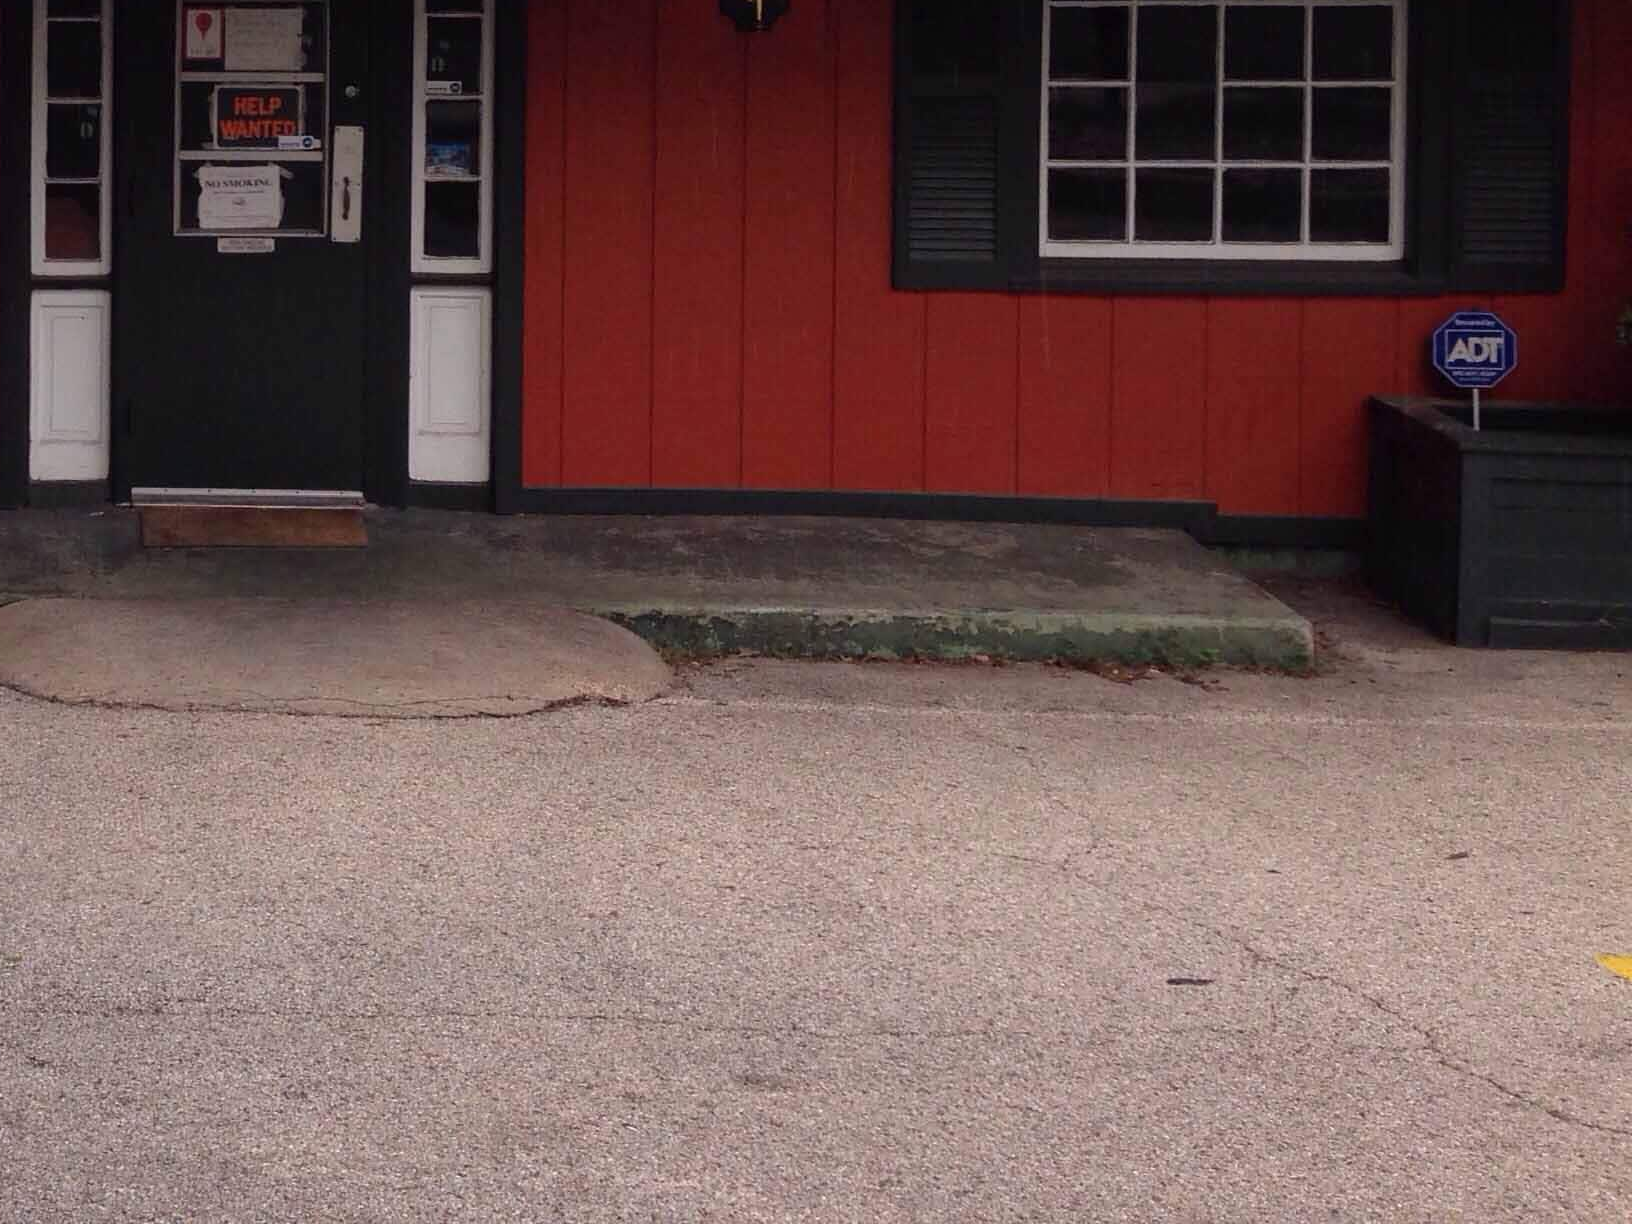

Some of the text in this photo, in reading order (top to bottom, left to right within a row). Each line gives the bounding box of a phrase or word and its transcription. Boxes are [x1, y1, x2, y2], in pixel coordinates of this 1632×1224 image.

[234, 96, 282, 116] HELP
[219, 119, 296, 140] WANTED
[204, 179, 221, 188] NO
[1447, 337, 1504, 364] ADT
